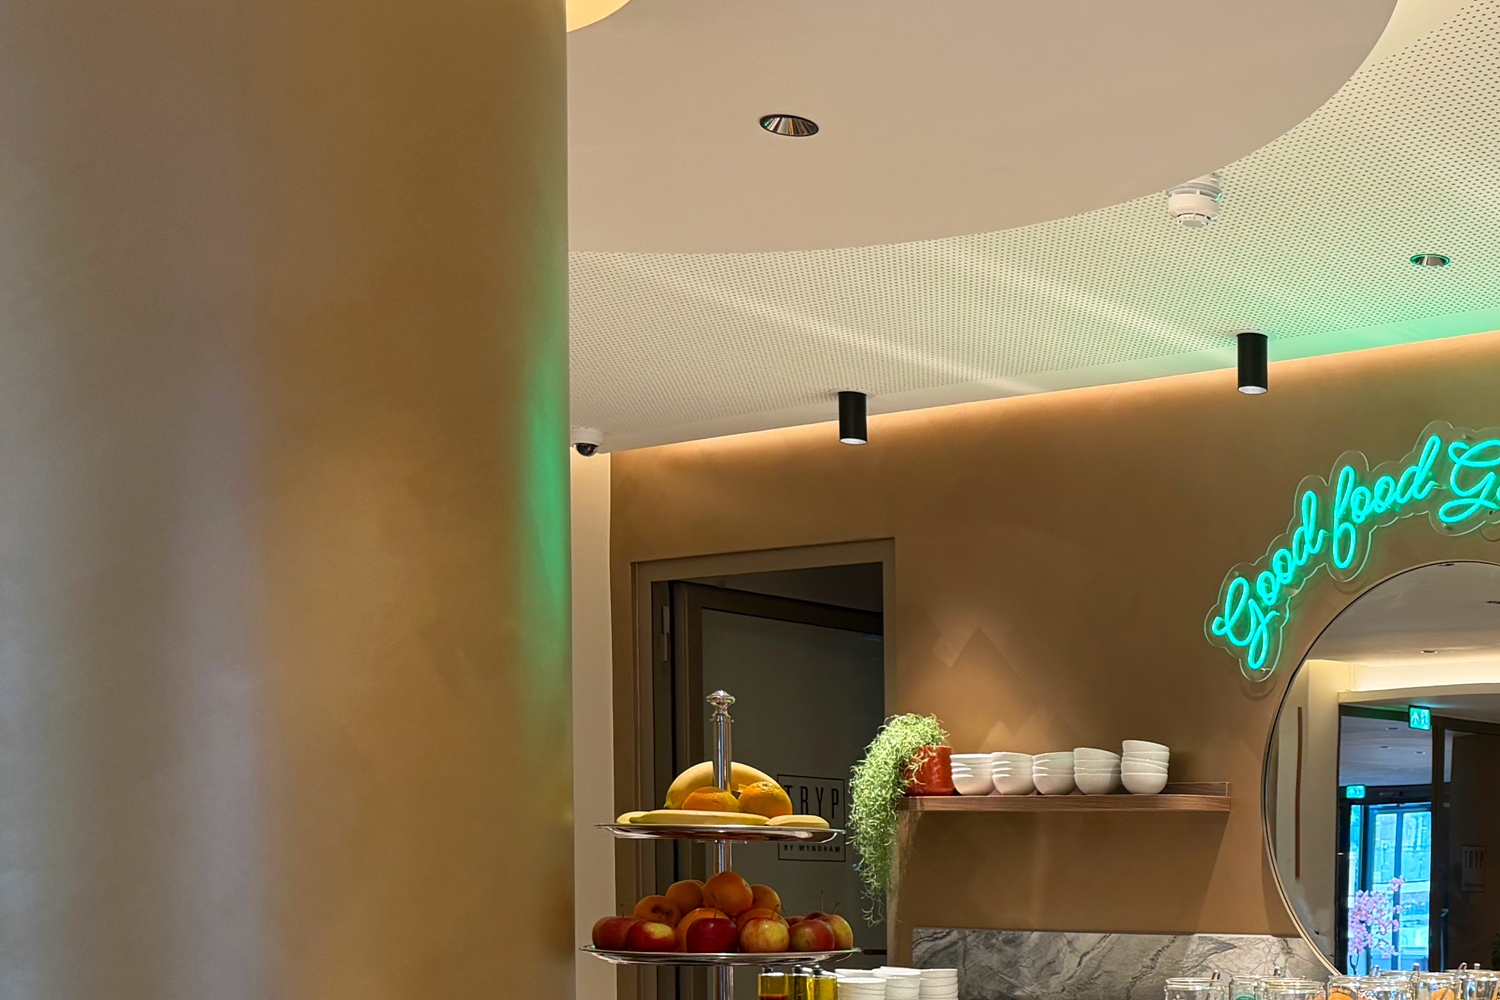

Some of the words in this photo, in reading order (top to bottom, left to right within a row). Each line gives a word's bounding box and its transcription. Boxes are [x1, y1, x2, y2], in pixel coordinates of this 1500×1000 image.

[1212, 491, 1326, 669] Good
[1333, 436, 1440, 568] food
[799, 844, 841, 852] WYNDHAM
